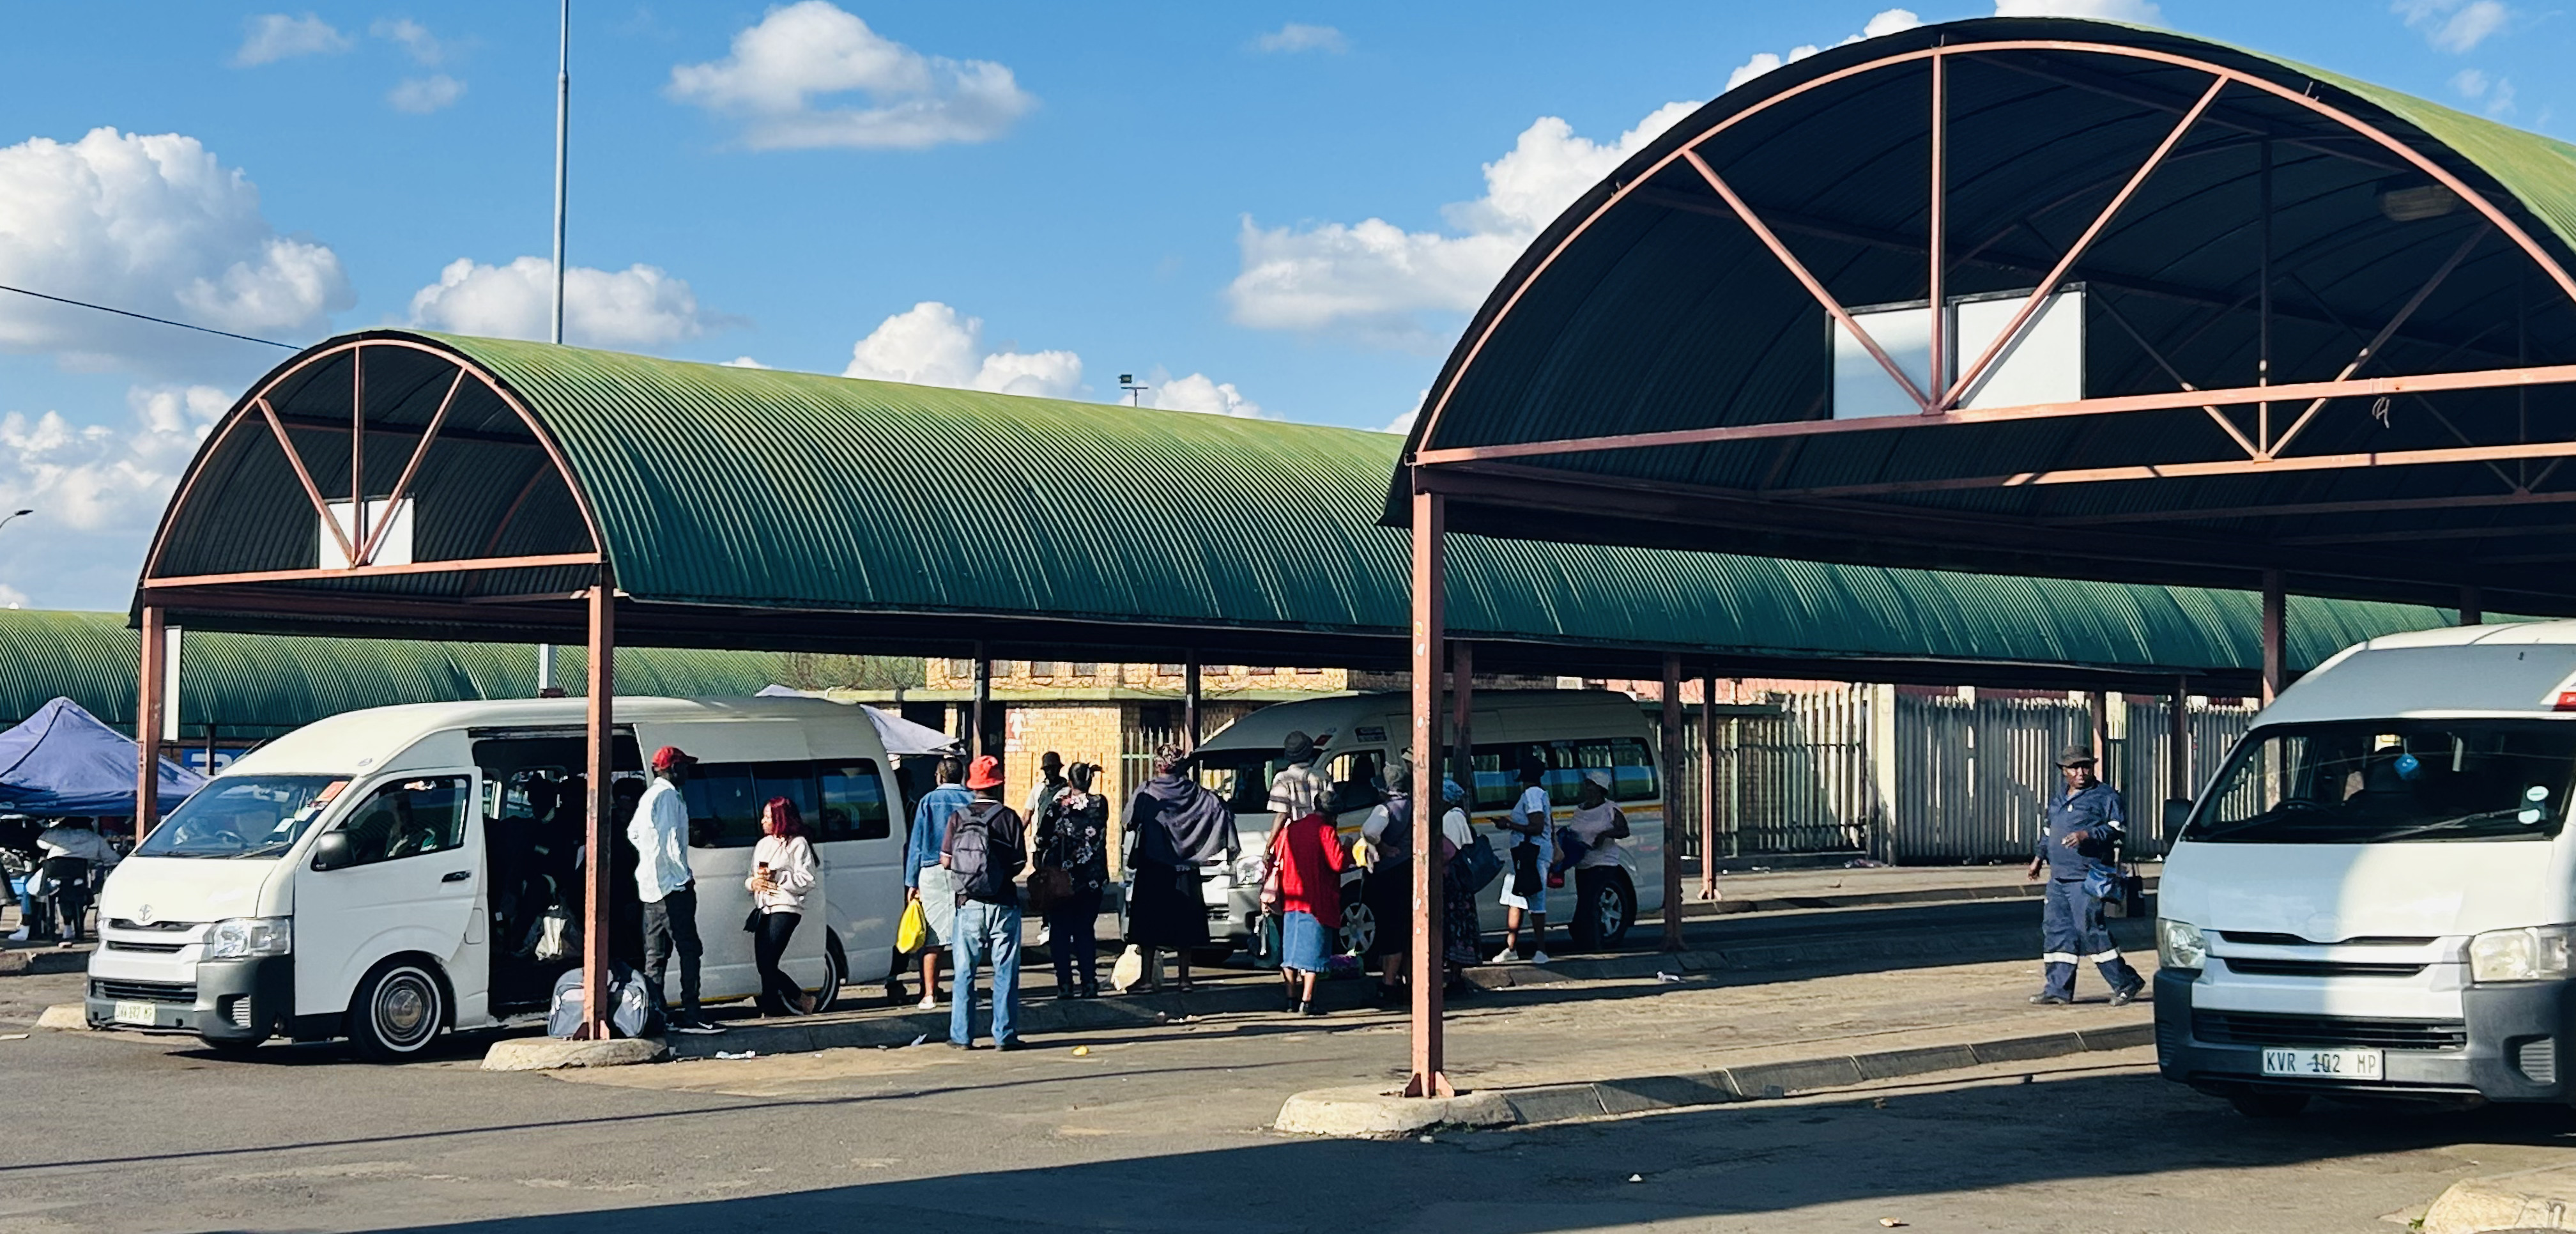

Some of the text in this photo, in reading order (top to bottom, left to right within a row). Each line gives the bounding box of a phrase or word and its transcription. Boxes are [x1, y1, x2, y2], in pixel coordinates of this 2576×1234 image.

[2267, 1052, 2376, 1074] KVR 102 MP
